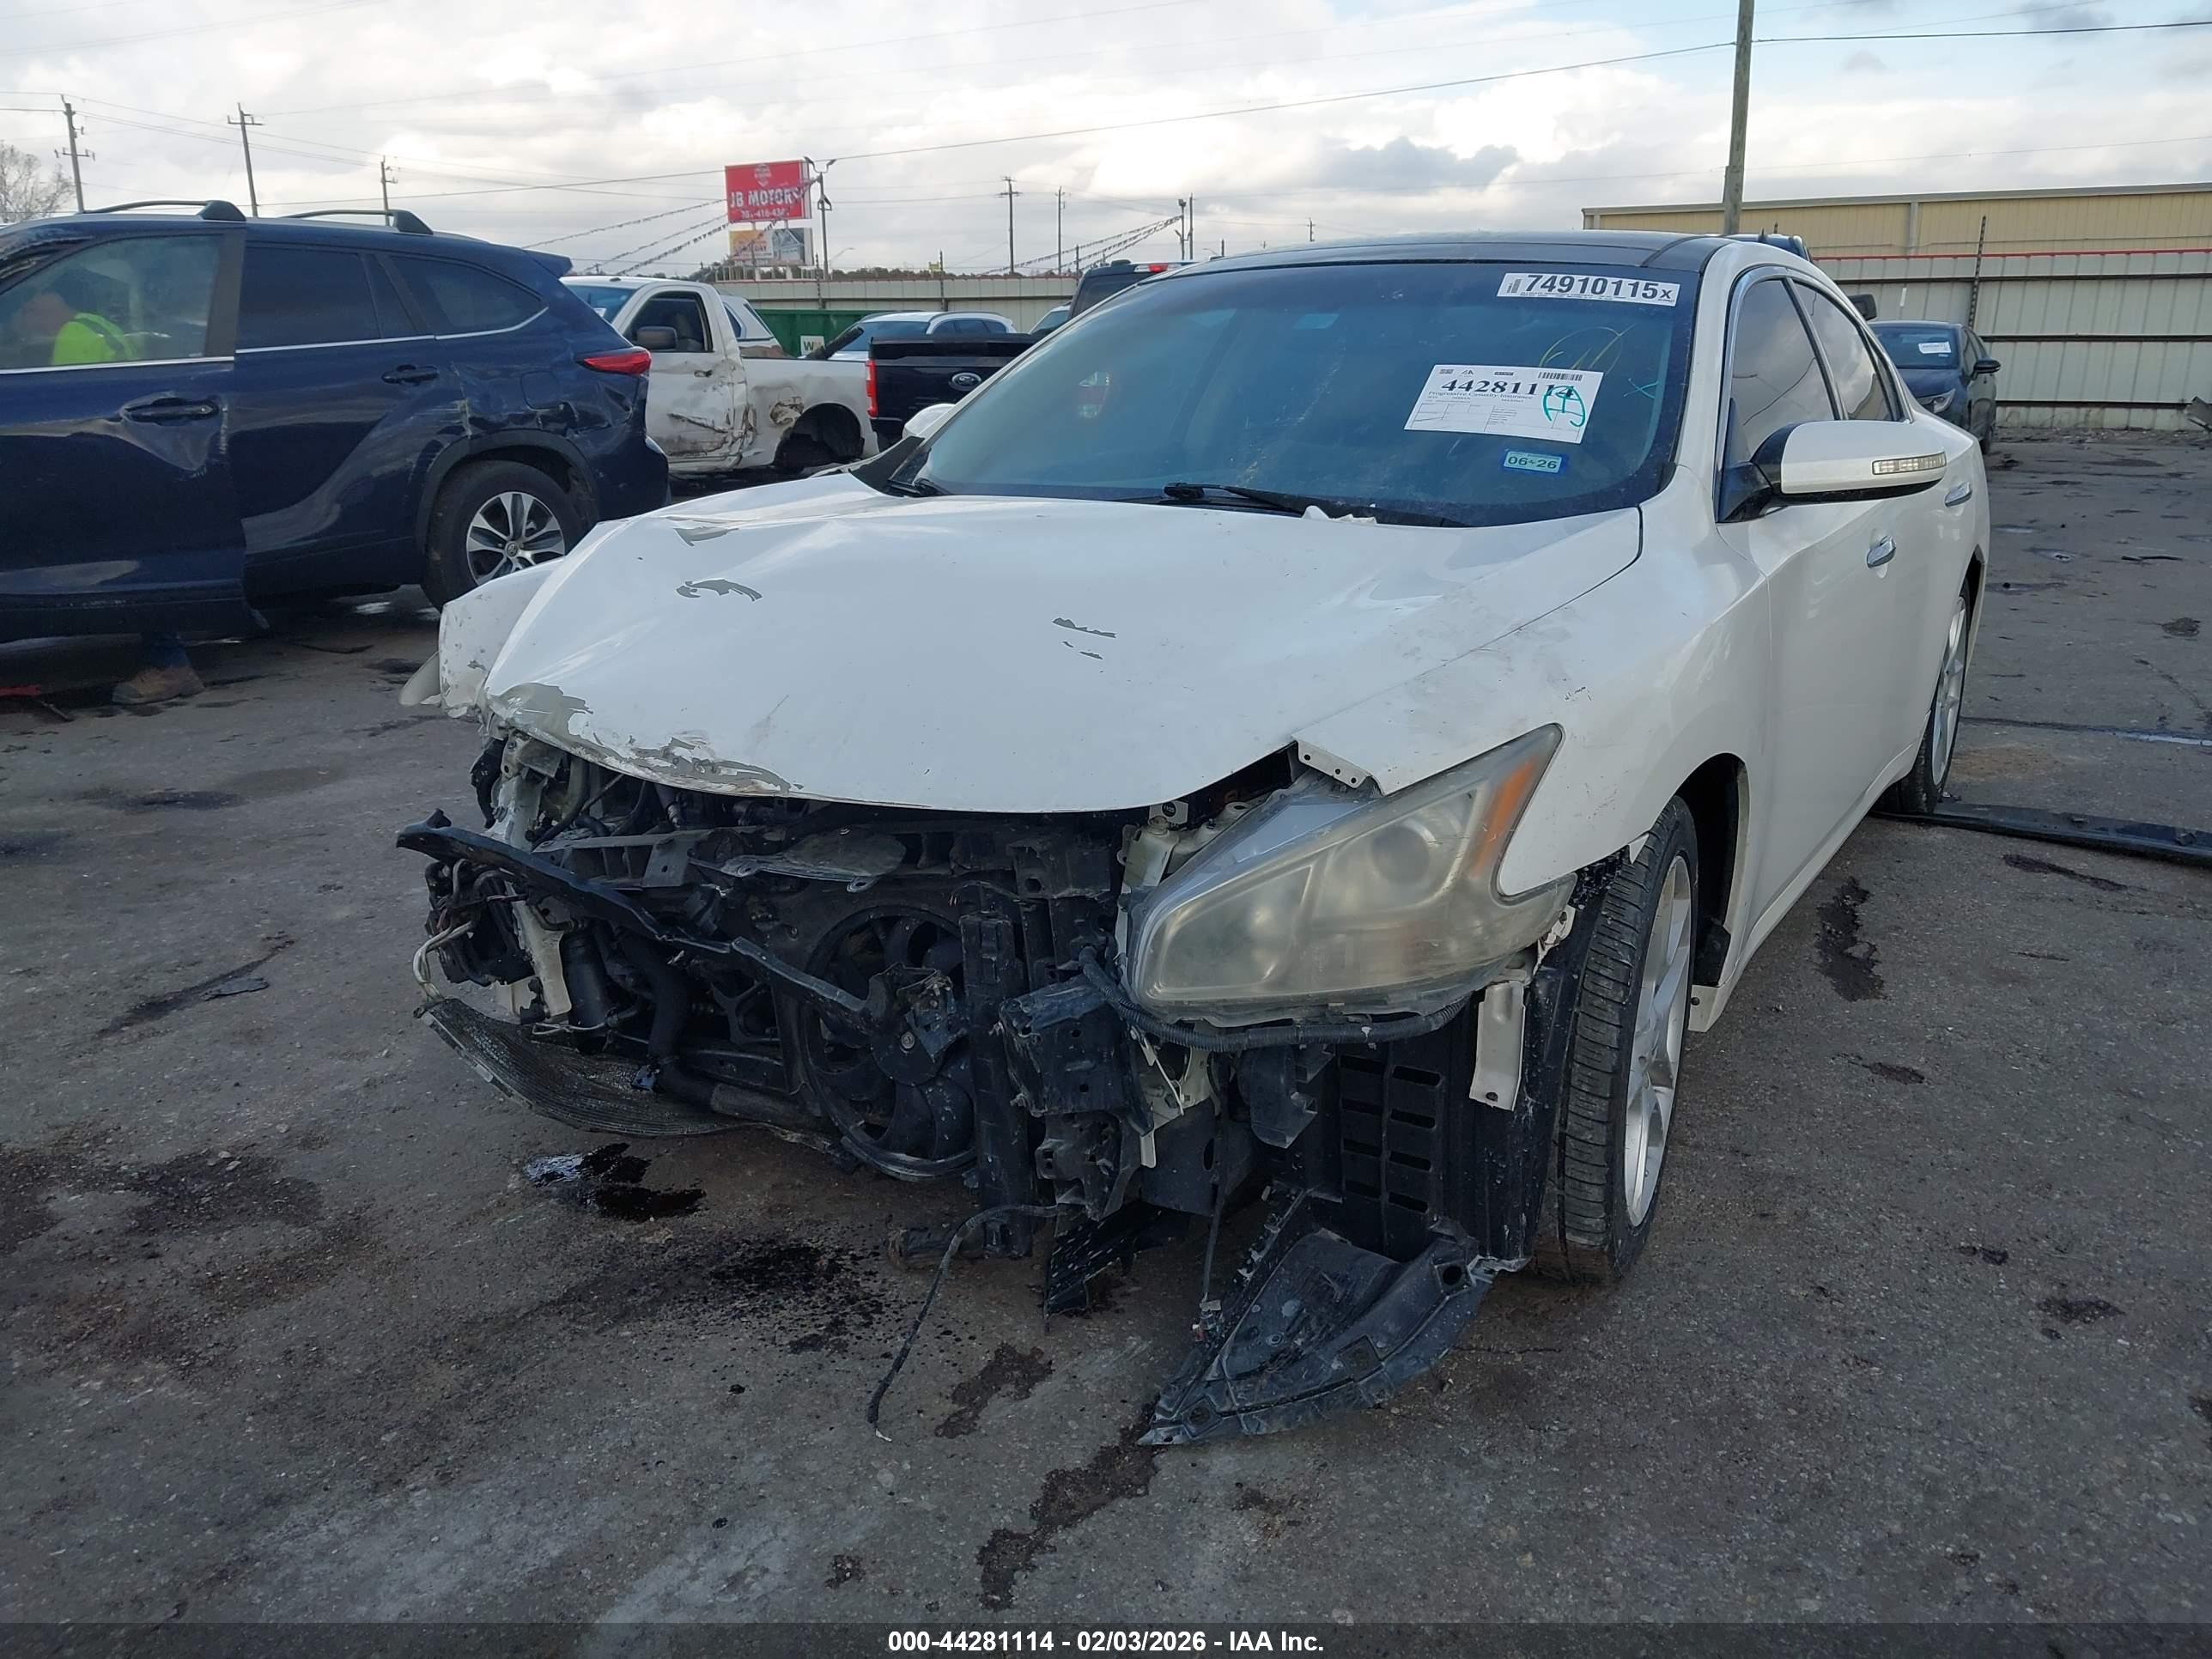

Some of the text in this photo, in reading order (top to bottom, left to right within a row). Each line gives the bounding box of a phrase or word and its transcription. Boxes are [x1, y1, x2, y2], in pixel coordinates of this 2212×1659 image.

[730, 191, 744, 208] JB
[1441, 378, 1575, 398] 44281114
[1507, 456, 1558, 470] 06 26
